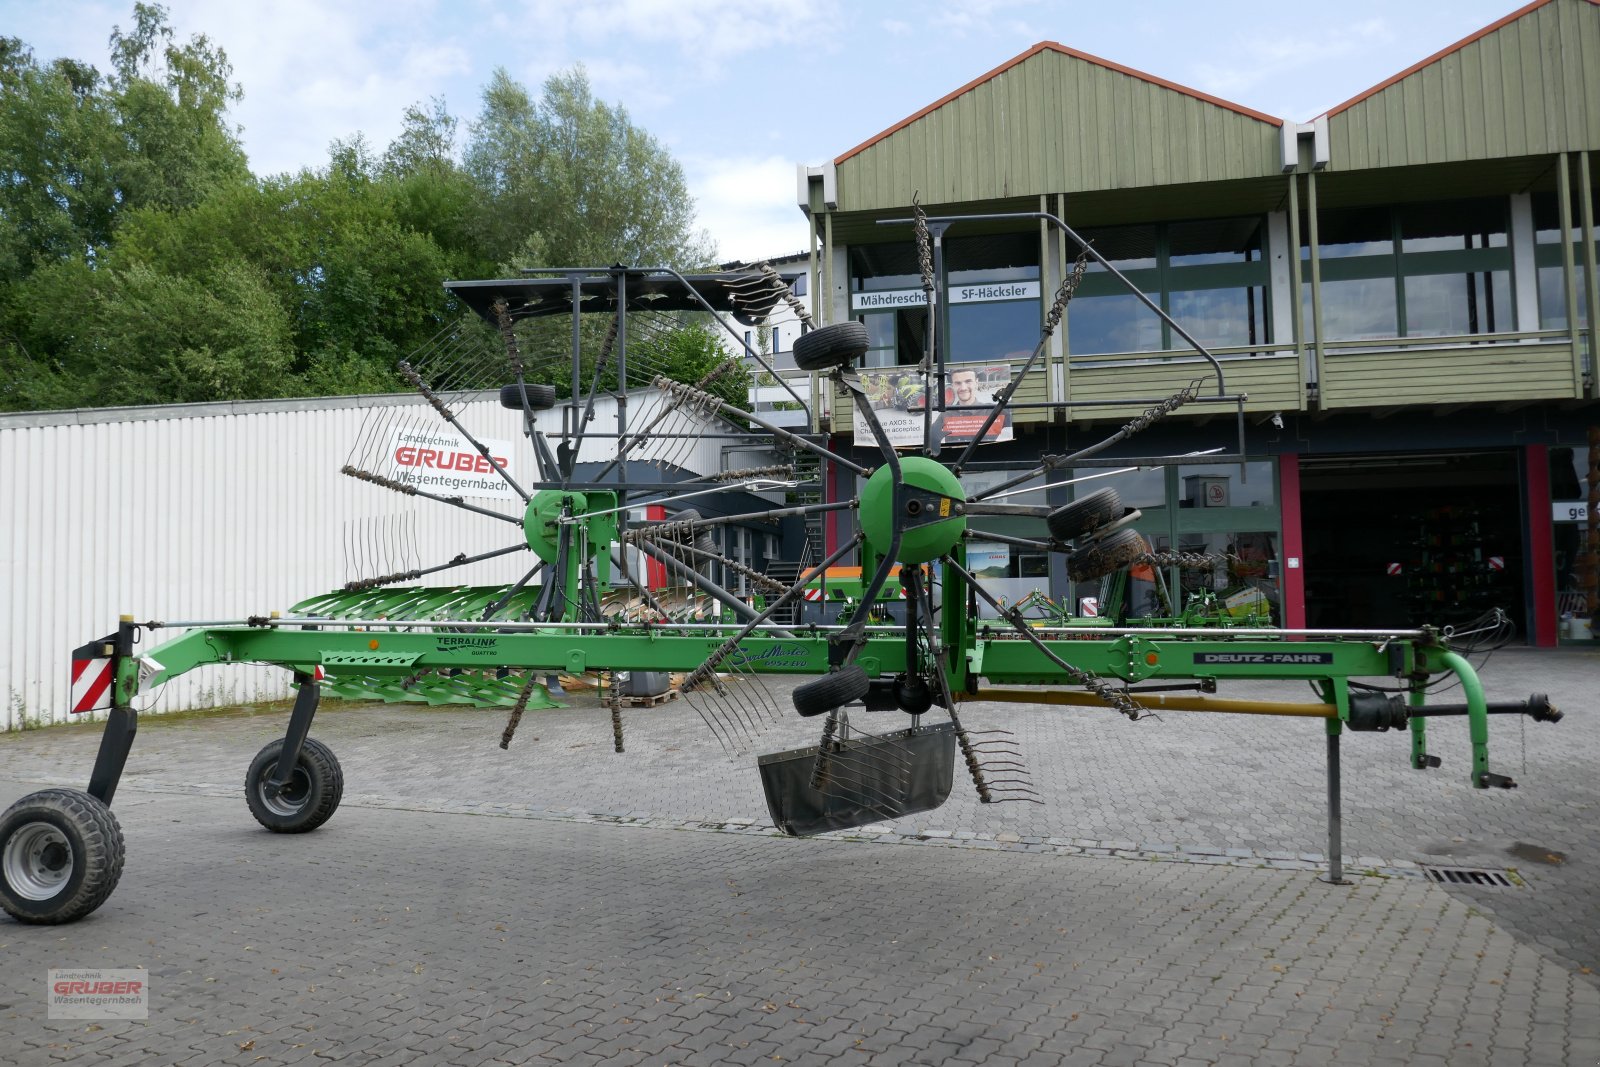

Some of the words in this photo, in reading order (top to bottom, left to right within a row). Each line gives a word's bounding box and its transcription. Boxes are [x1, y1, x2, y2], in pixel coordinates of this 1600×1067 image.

[961, 286, 1027, 299] SF-Häcksler
[398, 432, 460, 447] Landtechnik
[395, 446, 508, 474] GRUBER
[396, 471, 508, 491] Wasentegernbach
[436, 637, 497, 646] TERRALINK
[1205, 654, 1321, 663] DEUTZ-FAHR
